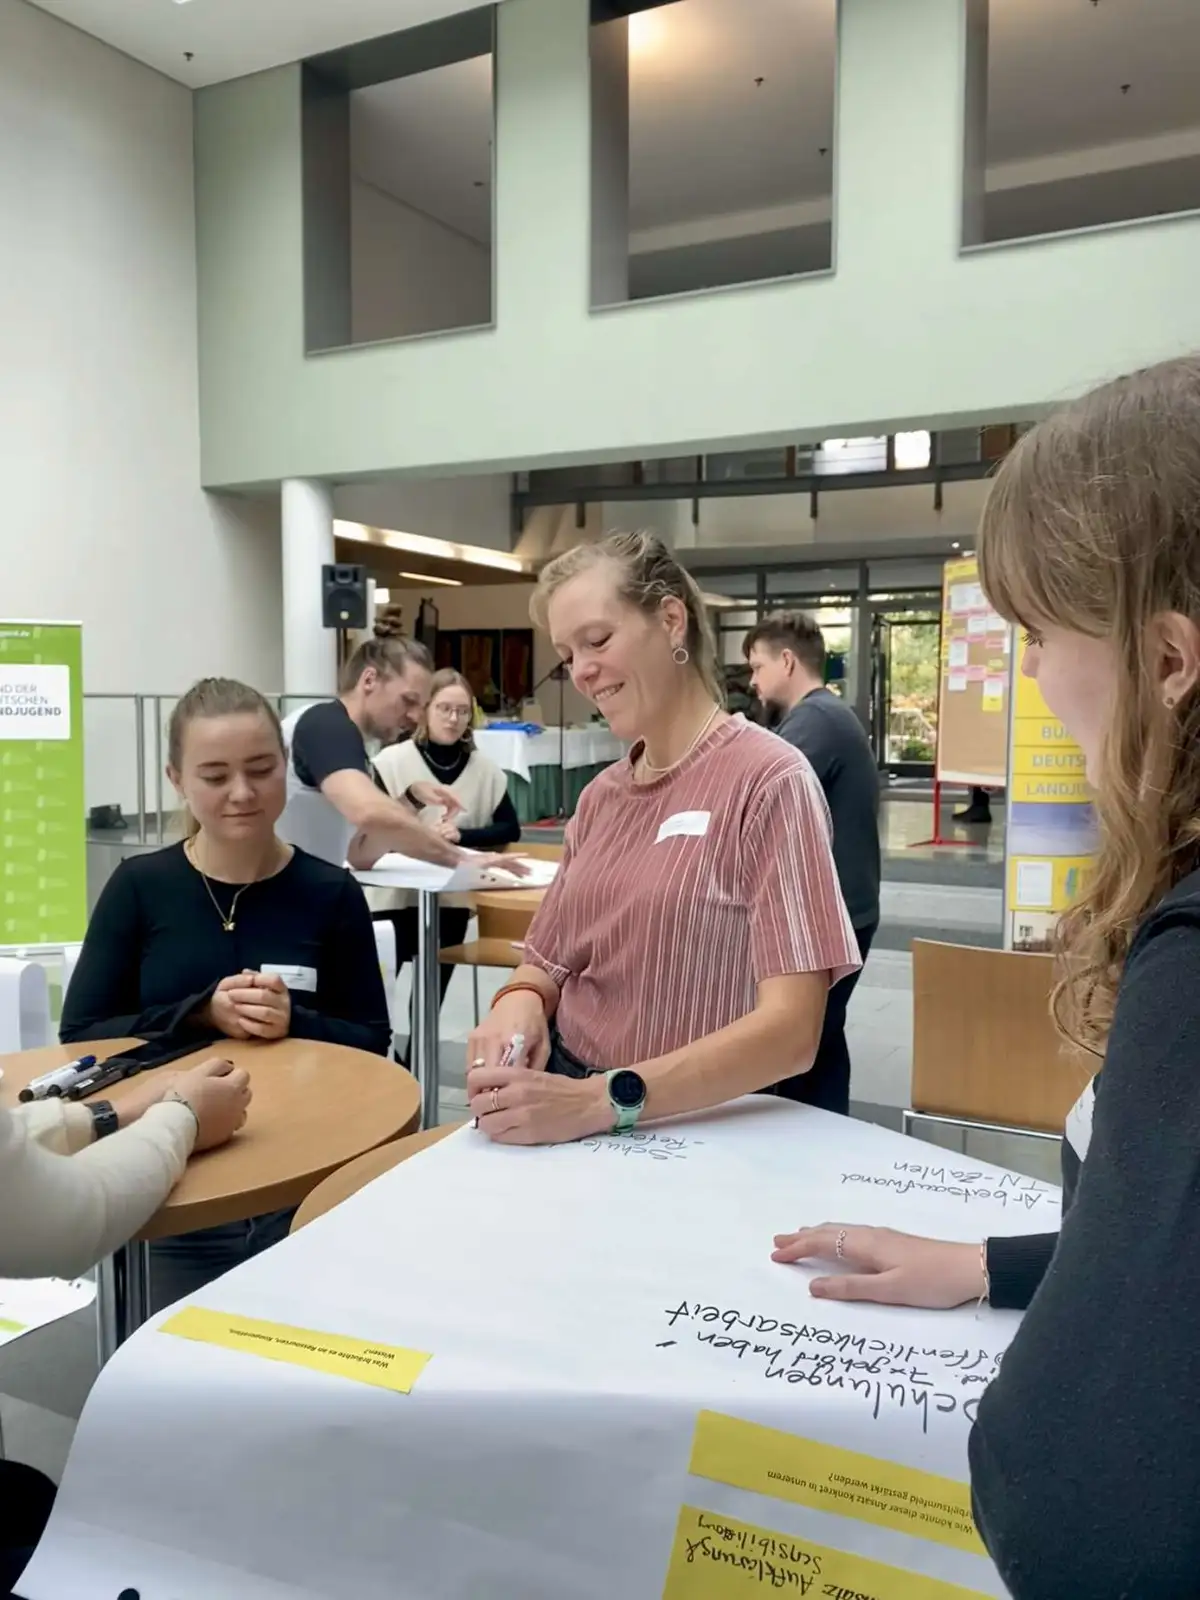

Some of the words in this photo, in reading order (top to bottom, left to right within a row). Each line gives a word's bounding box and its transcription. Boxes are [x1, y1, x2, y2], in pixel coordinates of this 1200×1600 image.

[15, 684, 37, 693] DER
[696, 1331, 781, 1365] haben
[372, 1359, 389, 1369] Was
[767, 1470, 807, 1488] unserem
[828, 1472, 869, 1490] werden?
[819, 1485, 854, 1501] konkret
[869, 1483, 909, 1500] gestärkt
[856, 1496, 887, 1511] Ansatz
[889, 1503, 918, 1519] dieser
[920, 1513, 952, 1529] könnte
[955, 1523, 973, 1534] Wie
